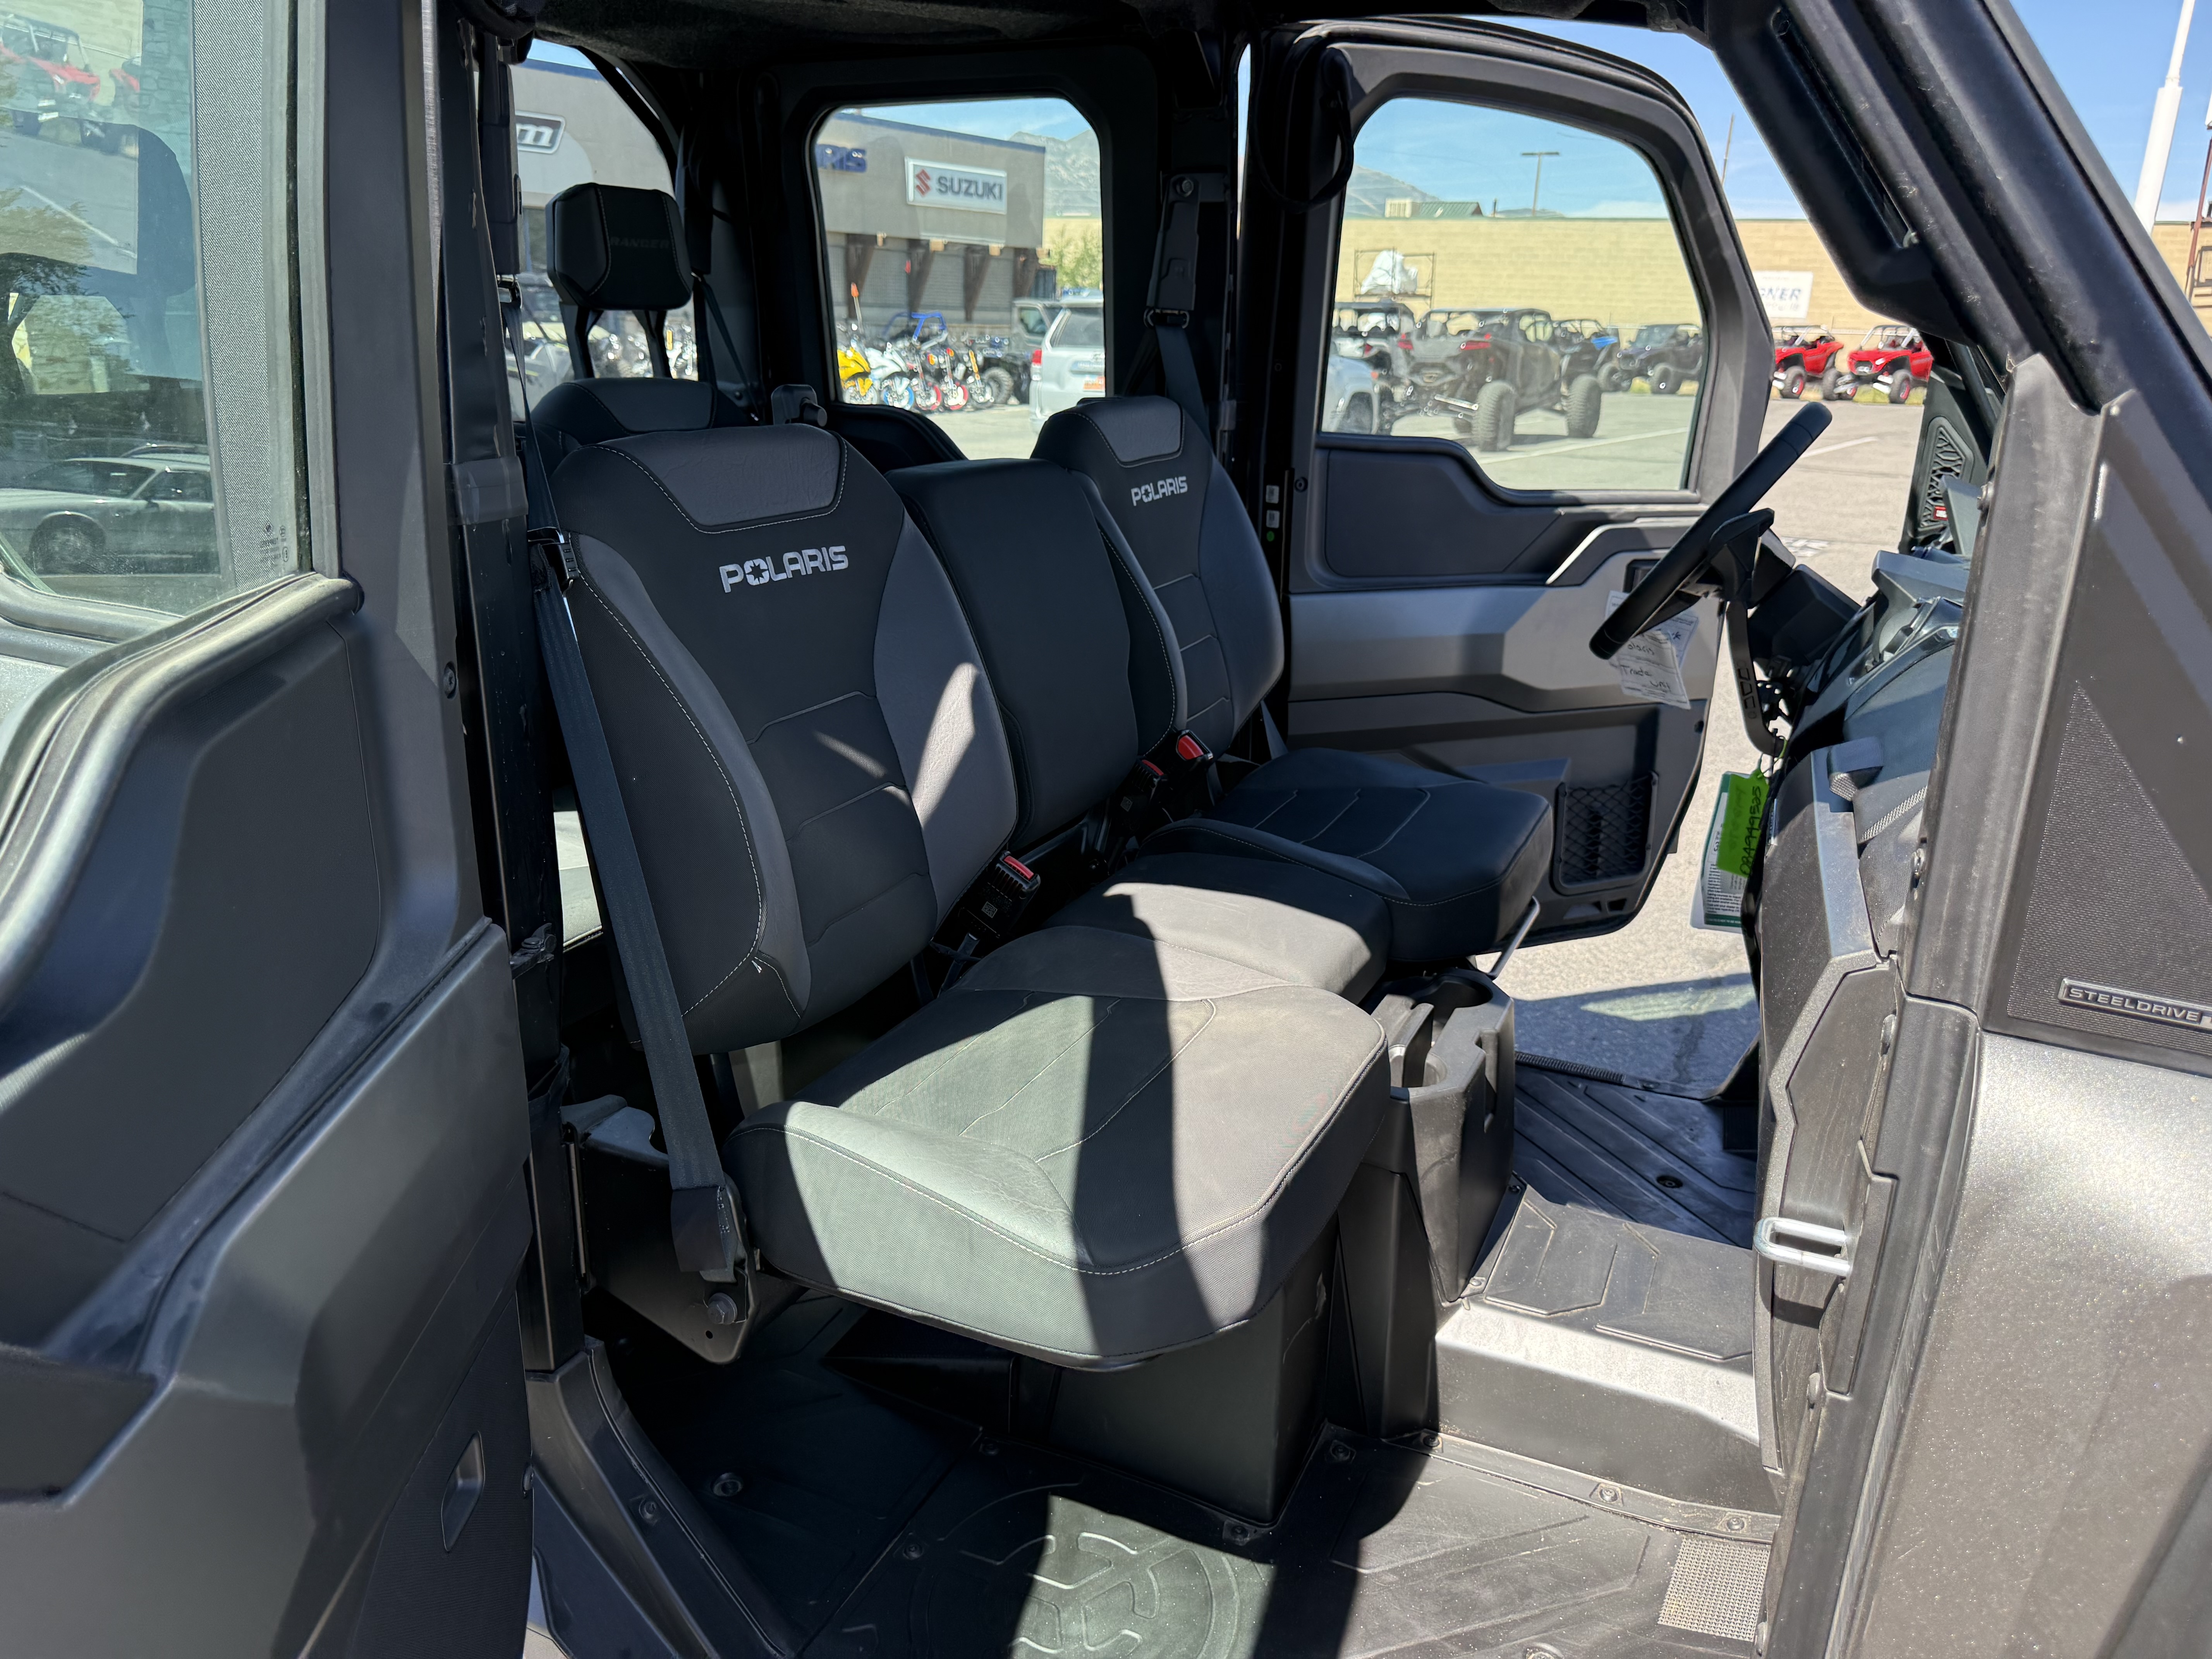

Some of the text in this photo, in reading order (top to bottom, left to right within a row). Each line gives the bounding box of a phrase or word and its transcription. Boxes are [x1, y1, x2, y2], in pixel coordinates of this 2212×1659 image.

[937, 175, 1003, 201] SUZUKI
[610, 237, 670, 249] RANGER
[1131, 476, 1188, 507] POLARIS
[719, 545, 848, 593] POLARIS
[2069, 988, 2201, 1022] STEELDRIVE
